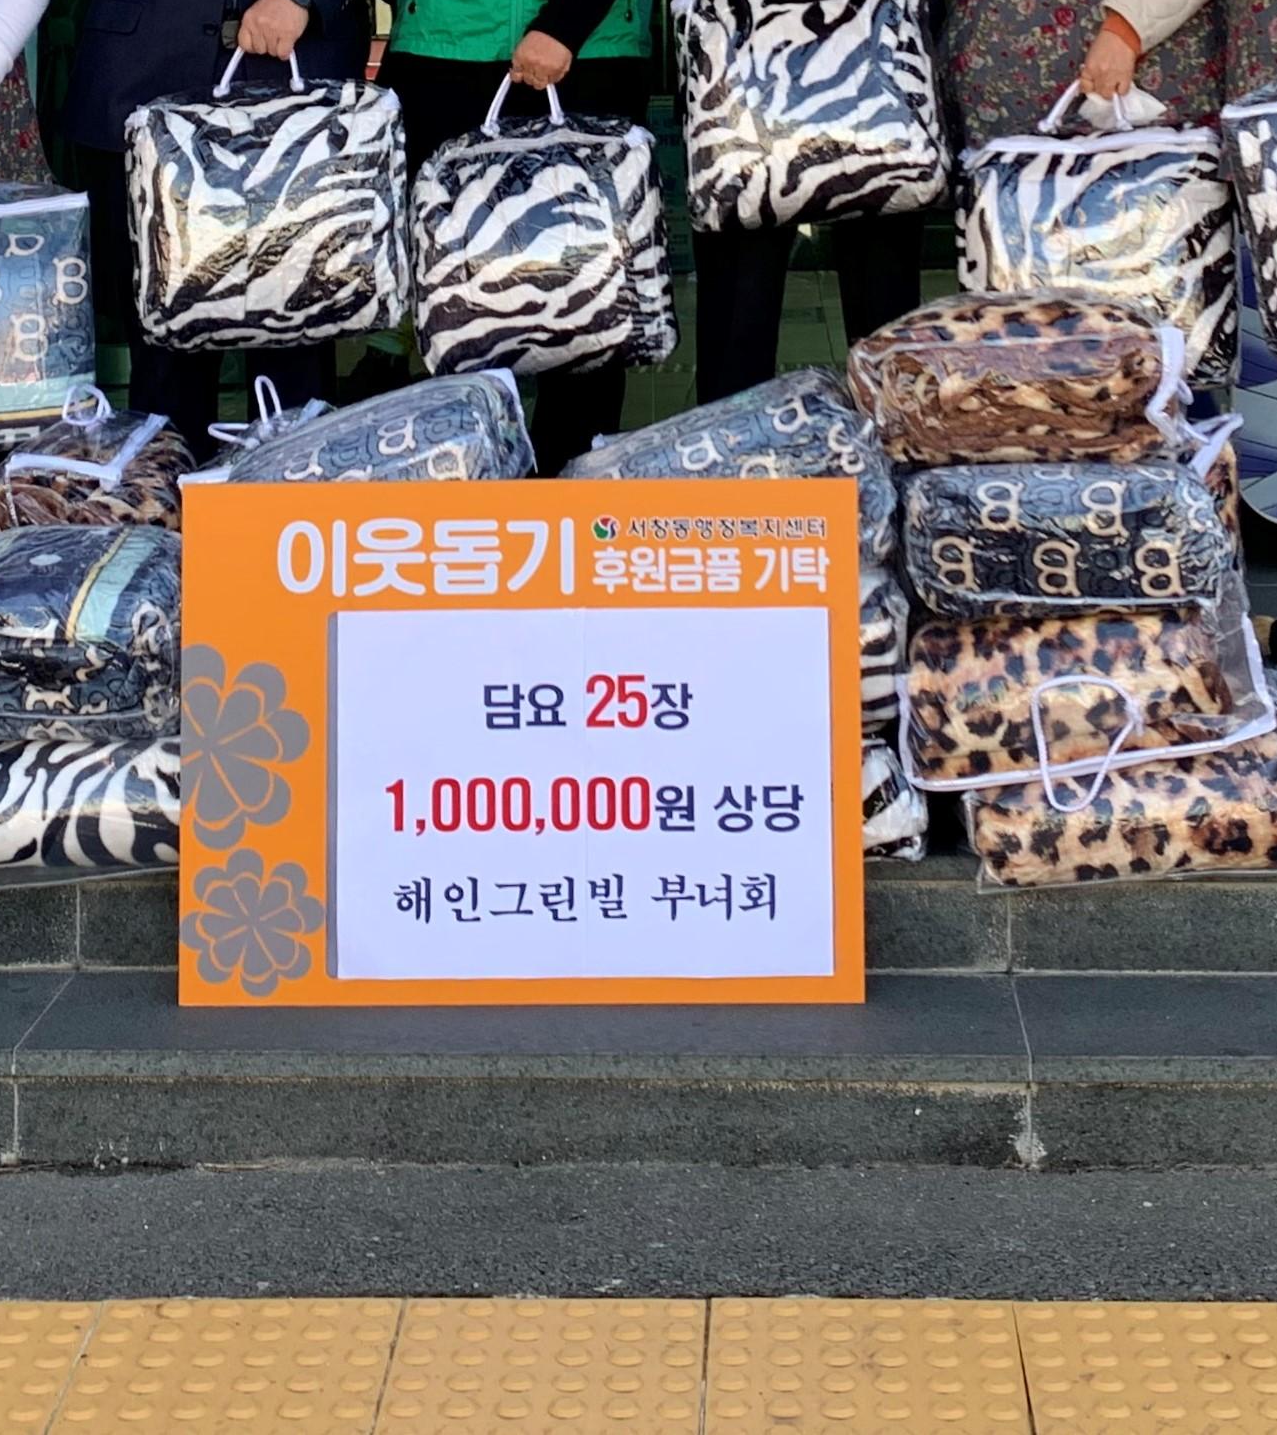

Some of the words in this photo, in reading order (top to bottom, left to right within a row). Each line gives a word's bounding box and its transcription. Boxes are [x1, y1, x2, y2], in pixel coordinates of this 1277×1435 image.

[626, 515, 828, 540] 서창동행정복지센터
[276, 516, 576, 597] 이웃돕기
[591, 545, 742, 594] 후원금품
[753, 545, 831, 594] 기탁
[481, 680, 567, 732] 담요
[584, 673, 694, 732] 25장
[384, 775, 695, 836] 1,000,000원
[712, 783, 805, 835] 상당
[393, 872, 628, 924] 해인그린빌
[650, 871, 778, 922] 부녀회
